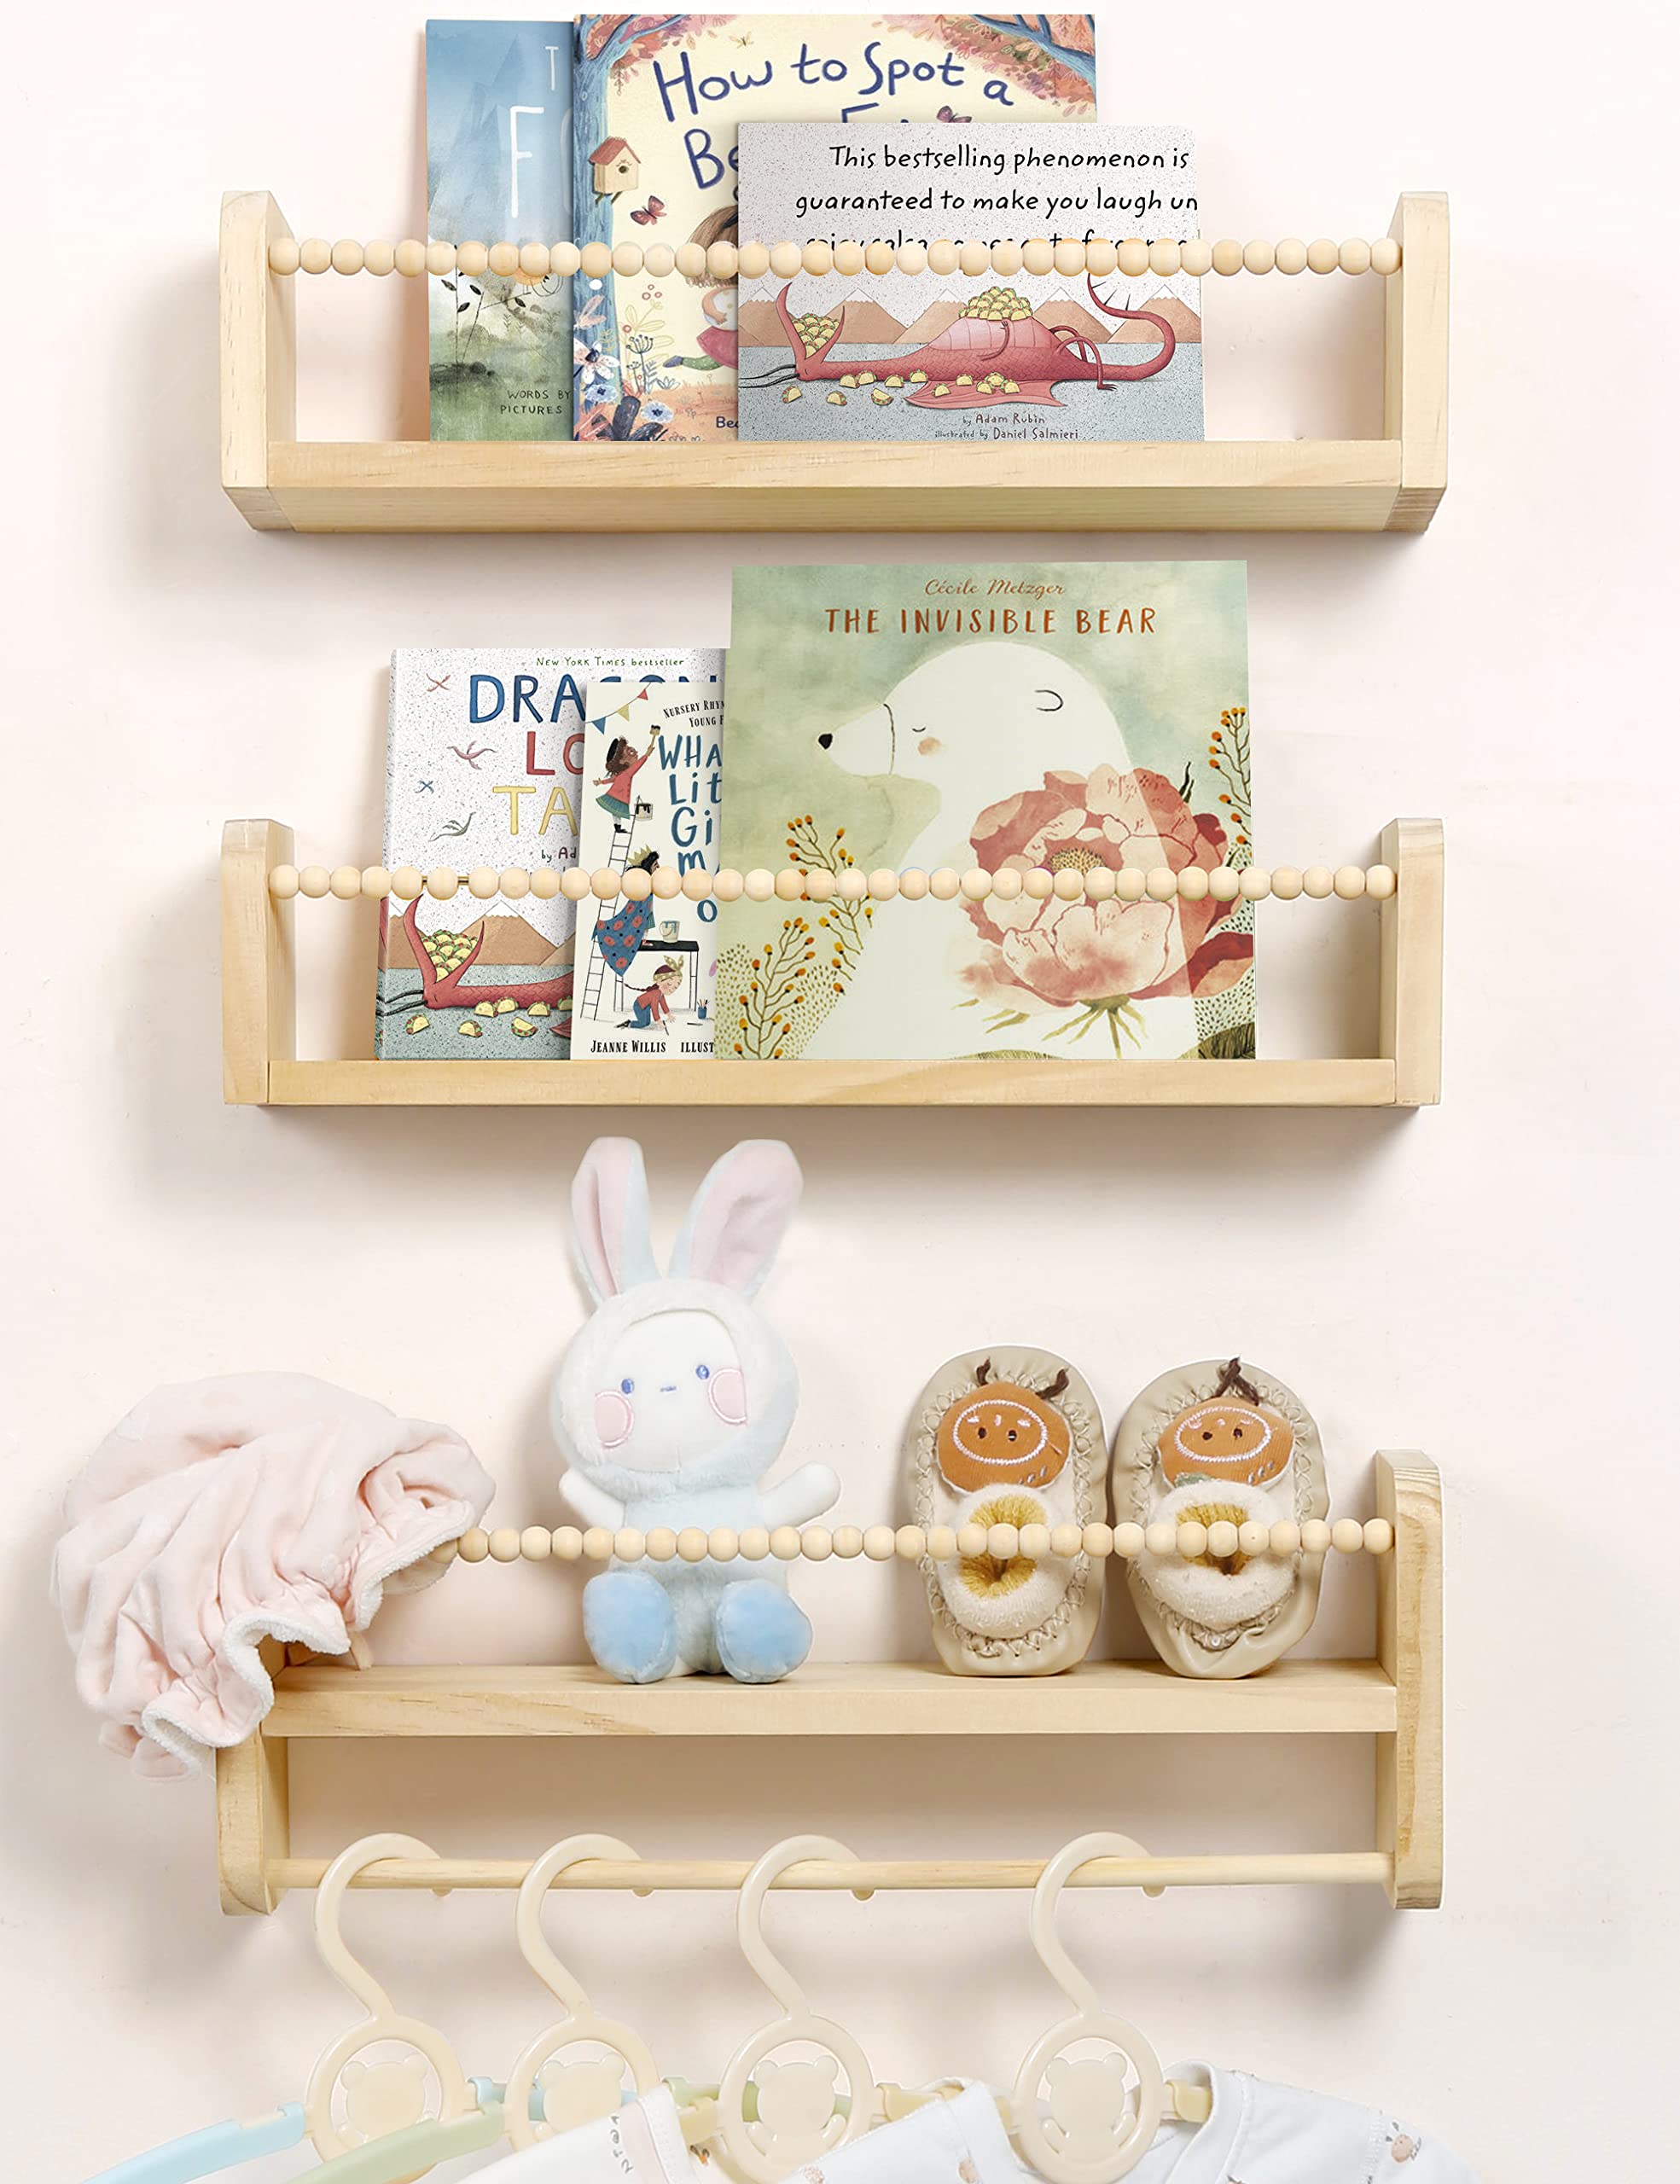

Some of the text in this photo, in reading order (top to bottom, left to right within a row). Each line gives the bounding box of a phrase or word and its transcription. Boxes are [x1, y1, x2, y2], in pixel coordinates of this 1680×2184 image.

[654, 42, 1014, 122] How to Spot a
[829, 143, 1189, 176] This bestselling phenomenon is
[796, 186, 1198, 219] guaranteed to make you laugh un
[508, 390, 571, 400] WORDS BY
[500, 404, 563, 415] PICTURES
[962, 413, 1045, 426] by Adam Rubin
[935, 427, 1078, 439] illustrated by Daniel Salmieri
[925, 578, 1067, 601] Cécile Metzger
[825, 607, 1156, 635] THE INVISIBLE BEAR
[536, 656, 684, 667] NEW YORK TIMES bestseller
[663, 702, 700, 718] NURSERY
[689, 717, 717, 728] YOUNG
[658, 735, 723, 770] WHA
[492, 786, 578, 836] TA
[541, 847, 577, 863] by Ad
[590, 1039, 715, 1053] JEANNE WILLIS ILLUST
